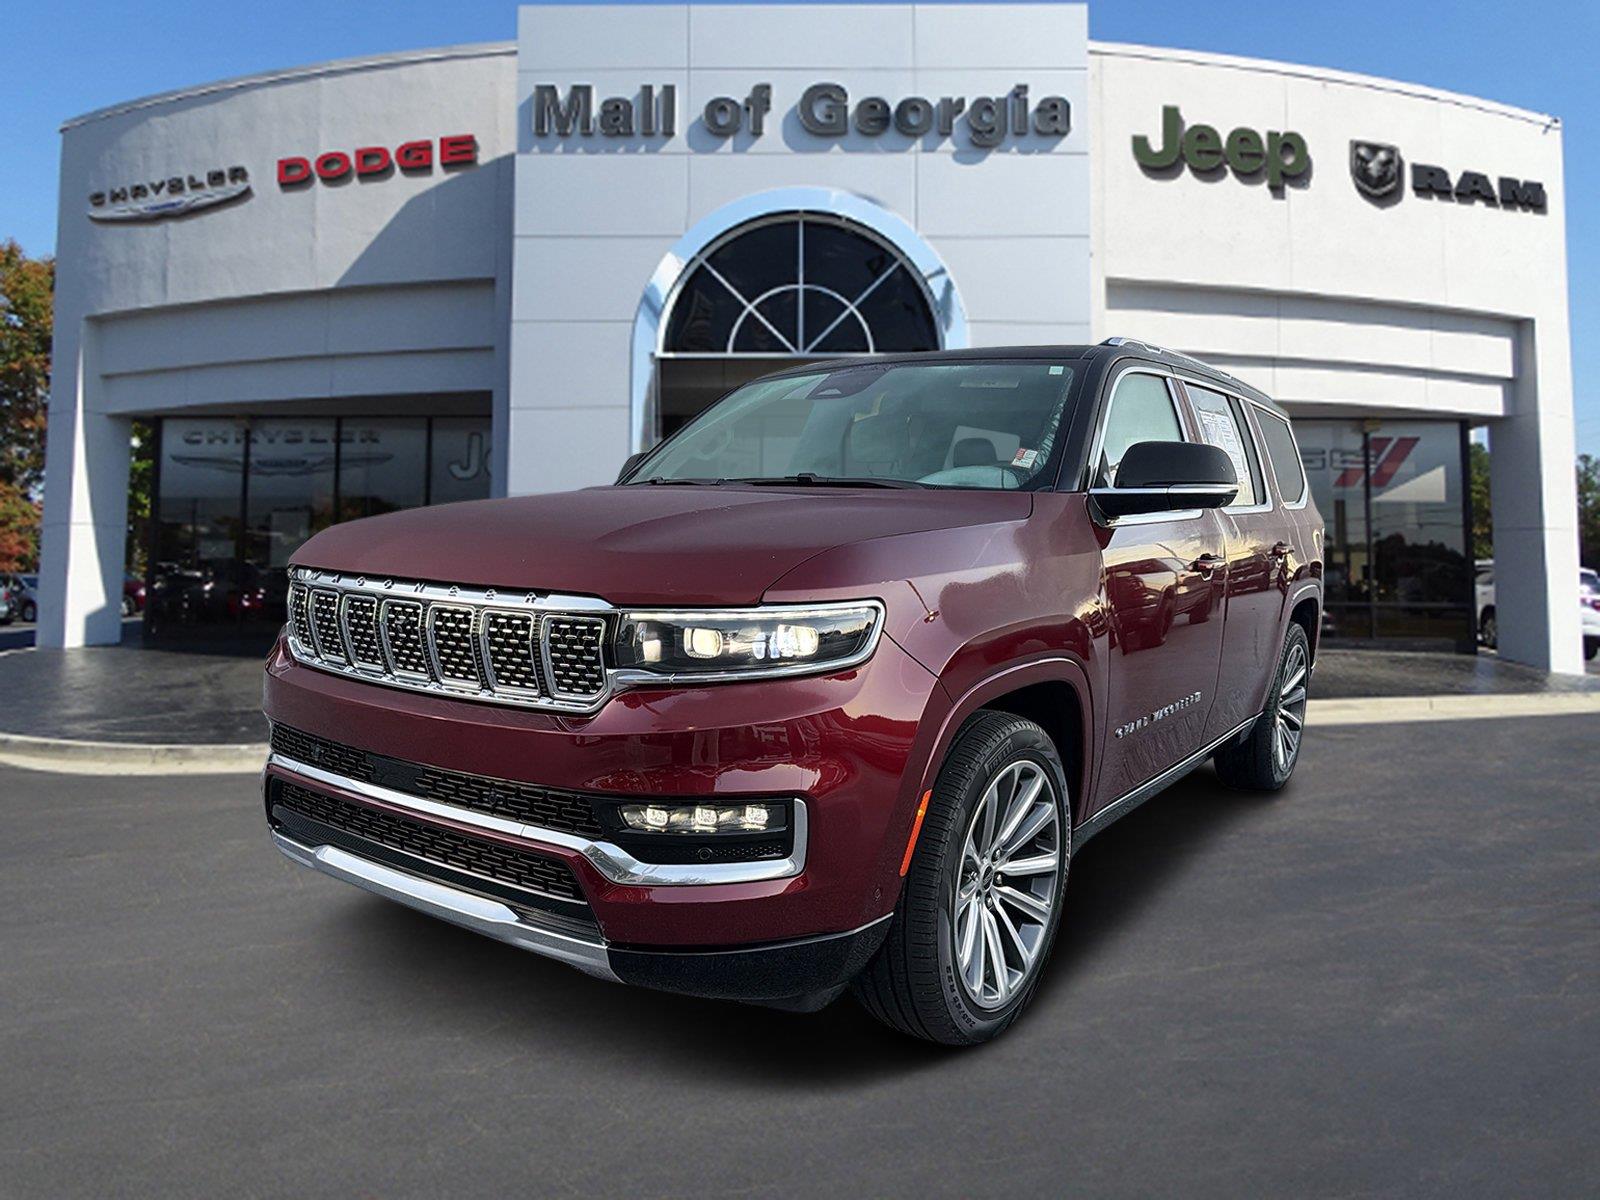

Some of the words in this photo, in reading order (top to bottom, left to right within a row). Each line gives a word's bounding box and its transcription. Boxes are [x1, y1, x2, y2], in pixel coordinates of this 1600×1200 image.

[533, 84, 676, 136] Mall
[704, 83, 772, 136] of
[799, 83, 1072, 147] Georgia
[277, 135, 478, 187] DODGE
[1131, 105, 1310, 196] Jeep
[88, 166, 249, 206] CHRYSLER
[1411, 163, 1547, 214] RAM
